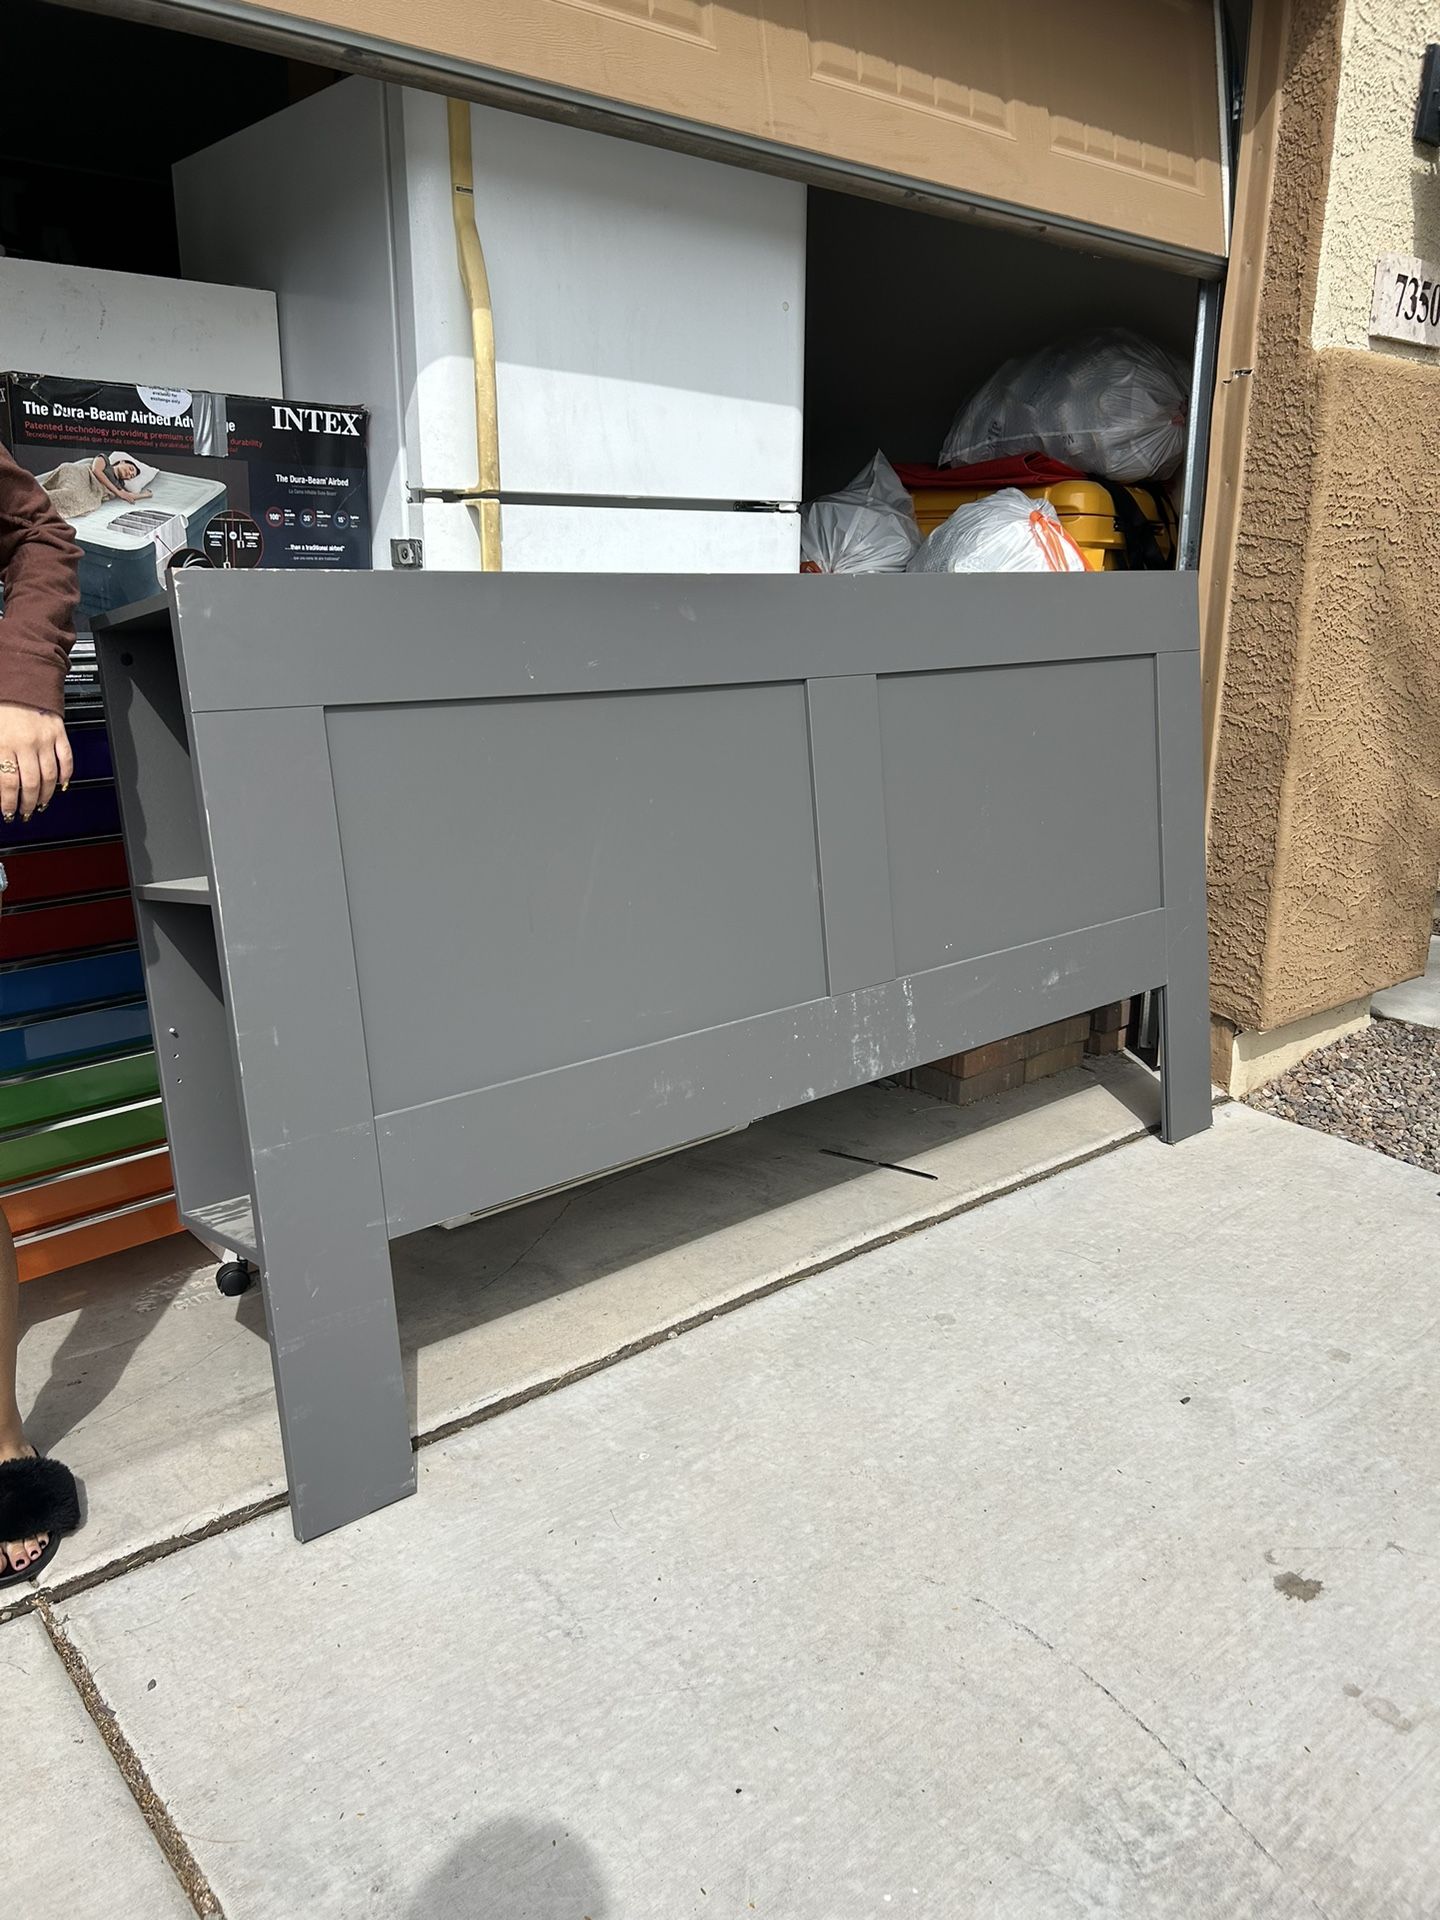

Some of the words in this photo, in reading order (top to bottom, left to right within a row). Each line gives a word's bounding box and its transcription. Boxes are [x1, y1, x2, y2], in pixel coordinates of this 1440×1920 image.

[23, 400, 49, 417] The
[131, 411, 171, 427] Airbed
[271, 405, 361, 437] INTEX
[25, 421, 63, 432] Patented
[65, 424, 109, 437] technology
[112, 429, 148, 441] providing
[150, 432, 184, 443] premium
[275, 473, 289, 483] The
[328, 478, 349, 487] Airbed
